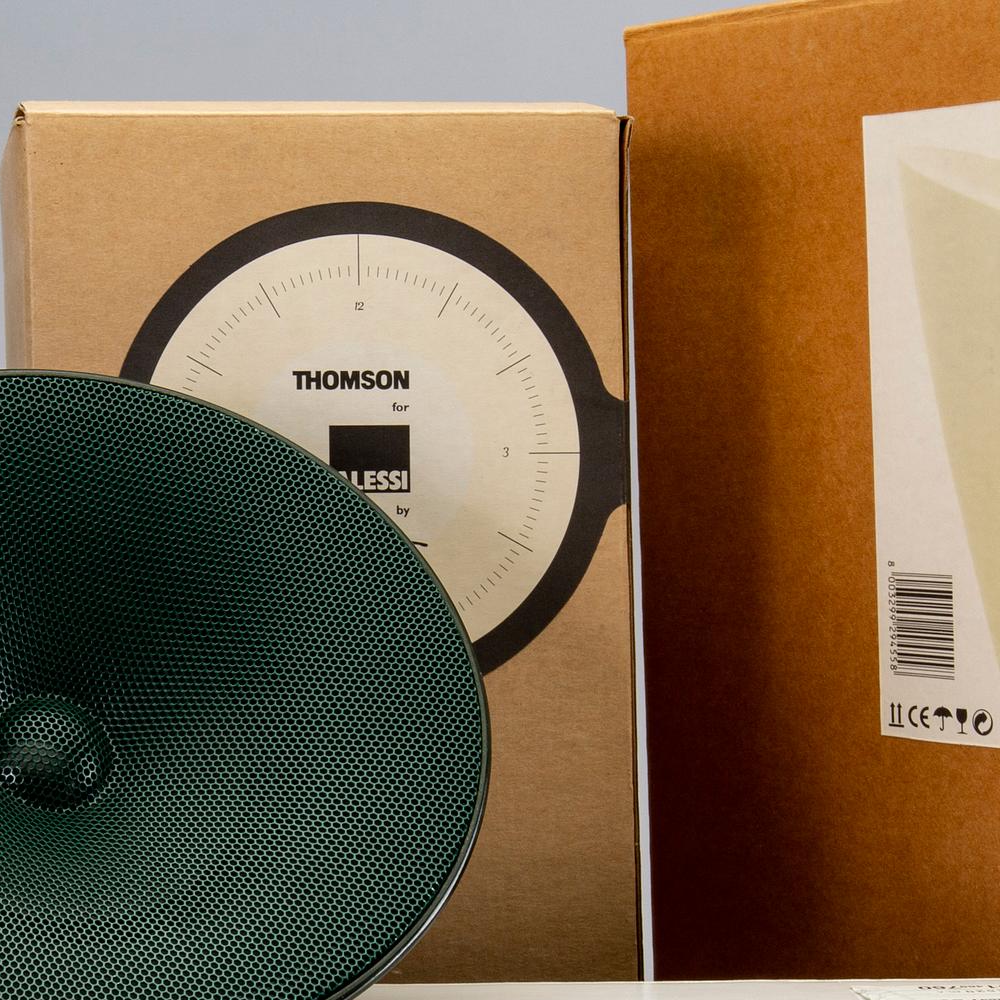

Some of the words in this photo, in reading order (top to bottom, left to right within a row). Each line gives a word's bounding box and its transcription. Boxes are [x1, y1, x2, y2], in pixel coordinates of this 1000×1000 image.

[354, 301, 365, 311] 12
[293, 370, 410, 390] THOMSON
[392, 402, 410, 412] for
[502, 447, 510, 459] 3
[396, 505, 410, 517] by
